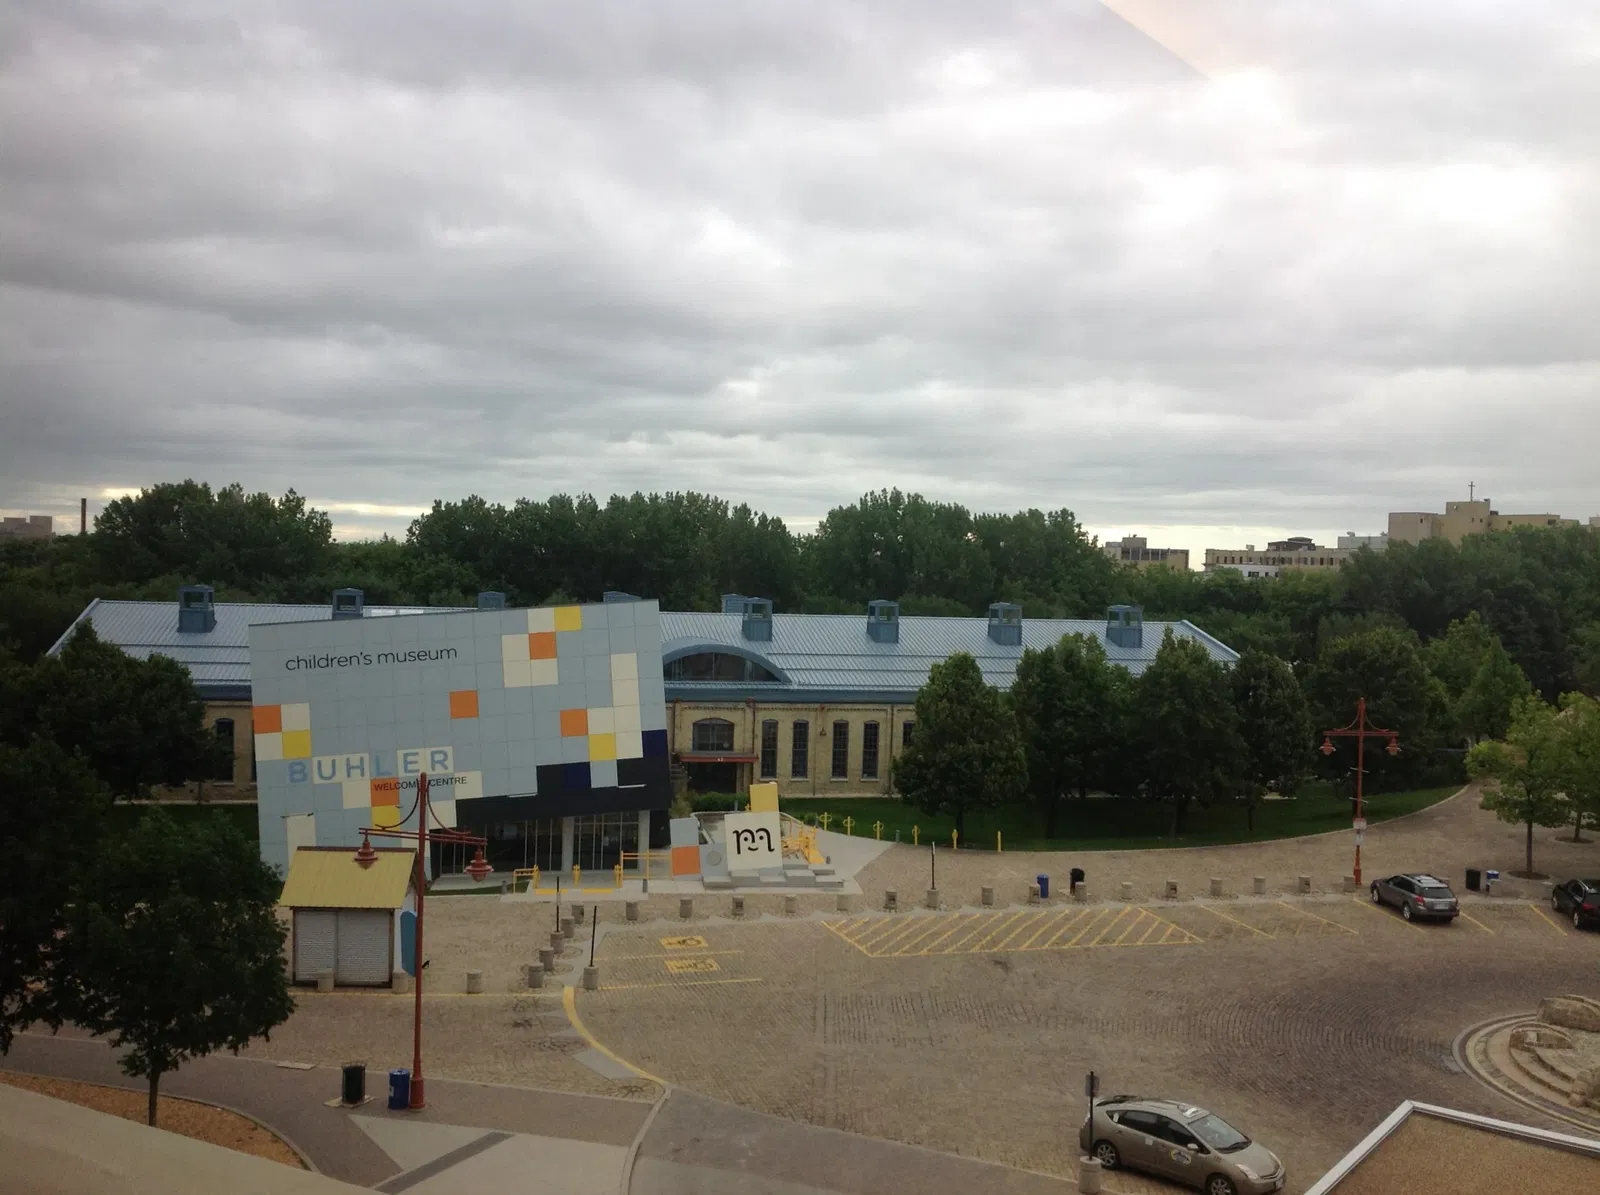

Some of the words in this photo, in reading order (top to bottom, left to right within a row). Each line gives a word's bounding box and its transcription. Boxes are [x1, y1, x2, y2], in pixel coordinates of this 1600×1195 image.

[285, 652, 373, 671] children's
[377, 647, 458, 665] museum
[287, 749, 450, 784] BUHLER
[429, 776, 468, 788] CENTRE
